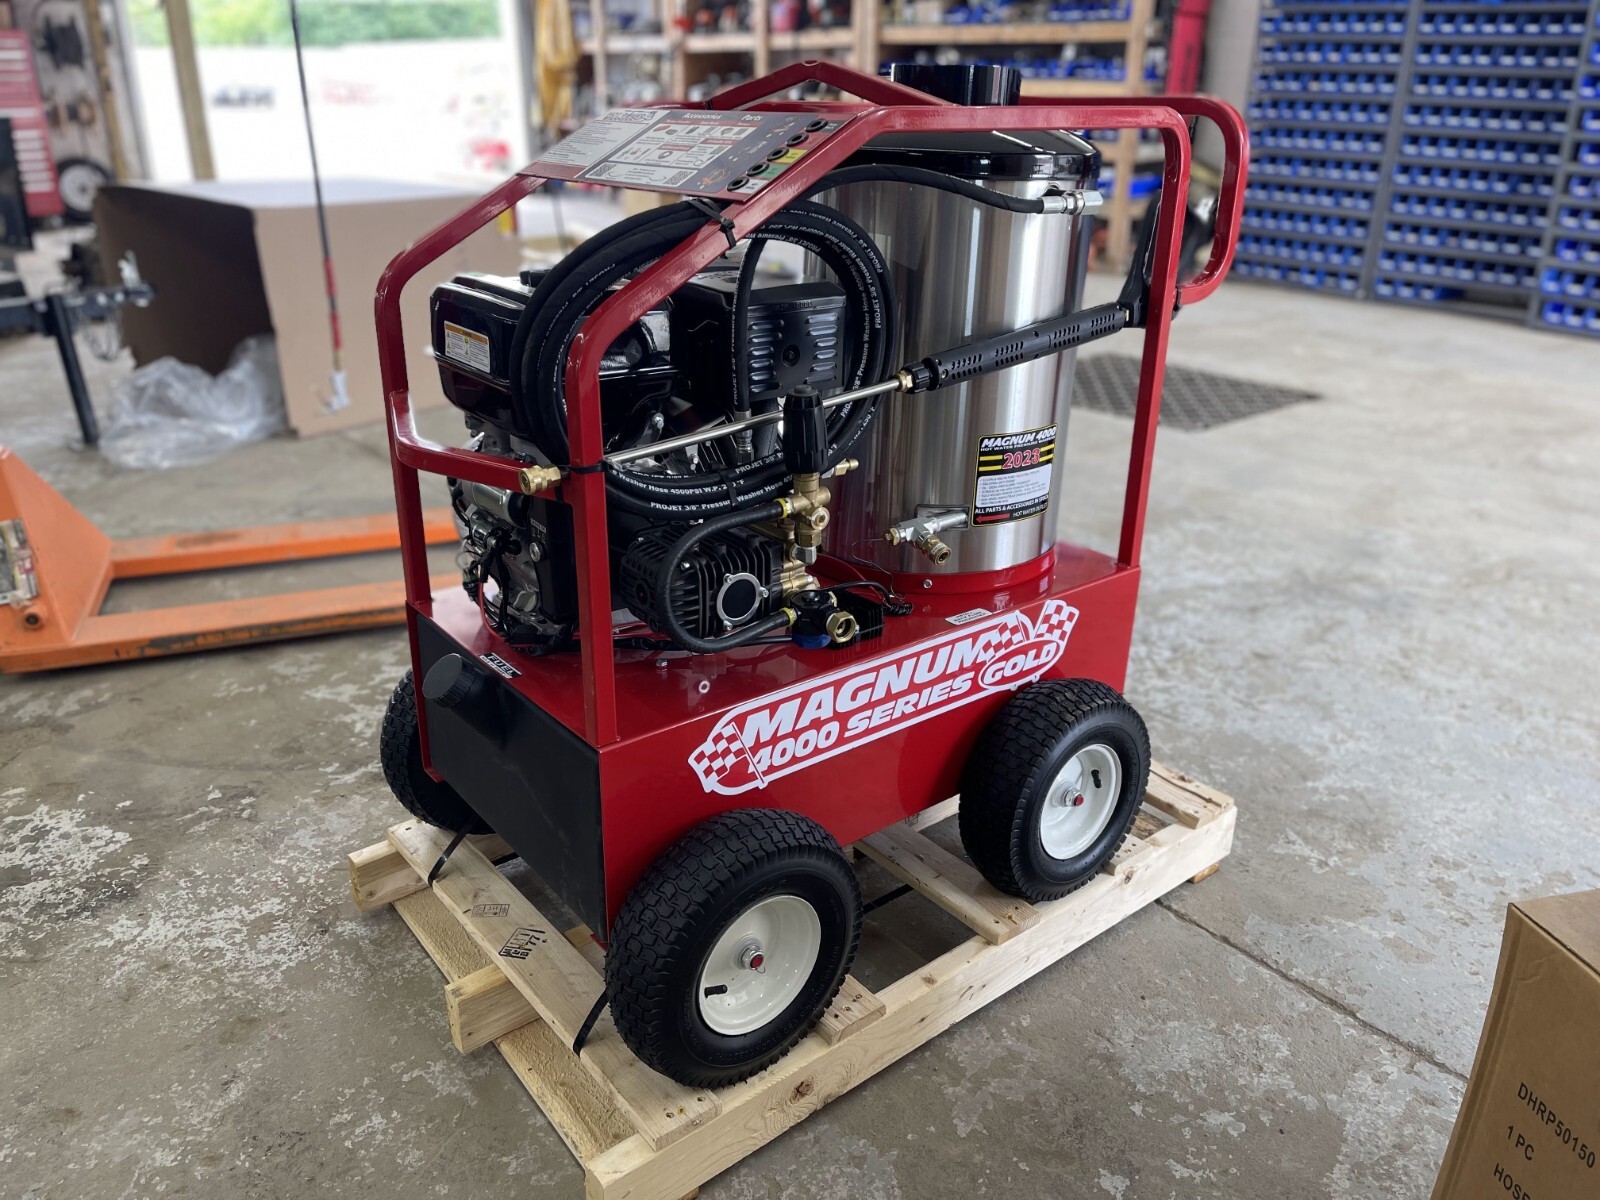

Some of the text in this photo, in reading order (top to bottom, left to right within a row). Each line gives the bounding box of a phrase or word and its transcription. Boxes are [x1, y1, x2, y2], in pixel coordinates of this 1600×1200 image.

[872, 299, 882, 329] PROJET
[981, 427, 1057, 448] MAGNUM 4000
[734, 461, 763, 475] PROJET
[1002, 447, 1041, 470] 2023
[648, 484, 669, 493] Hose
[650, 501, 683, 511] PROJET
[701, 500, 731, 510] Pressur
[736, 488, 764, 503] Washer
[764, 481, 783, 493] Hose
[985, 505, 1002, 513] PARTS
[487, 655, 513, 676] FUEL
[983, 642, 1055, 685] GOLD
[738, 628, 995, 748] MAGNUM
[748, 672, 975, 774] 4000 SERIES
[1517, 1082, 1596, 1169] DHRP50150
[1507, 1125, 1535, 1161] 1 PC
